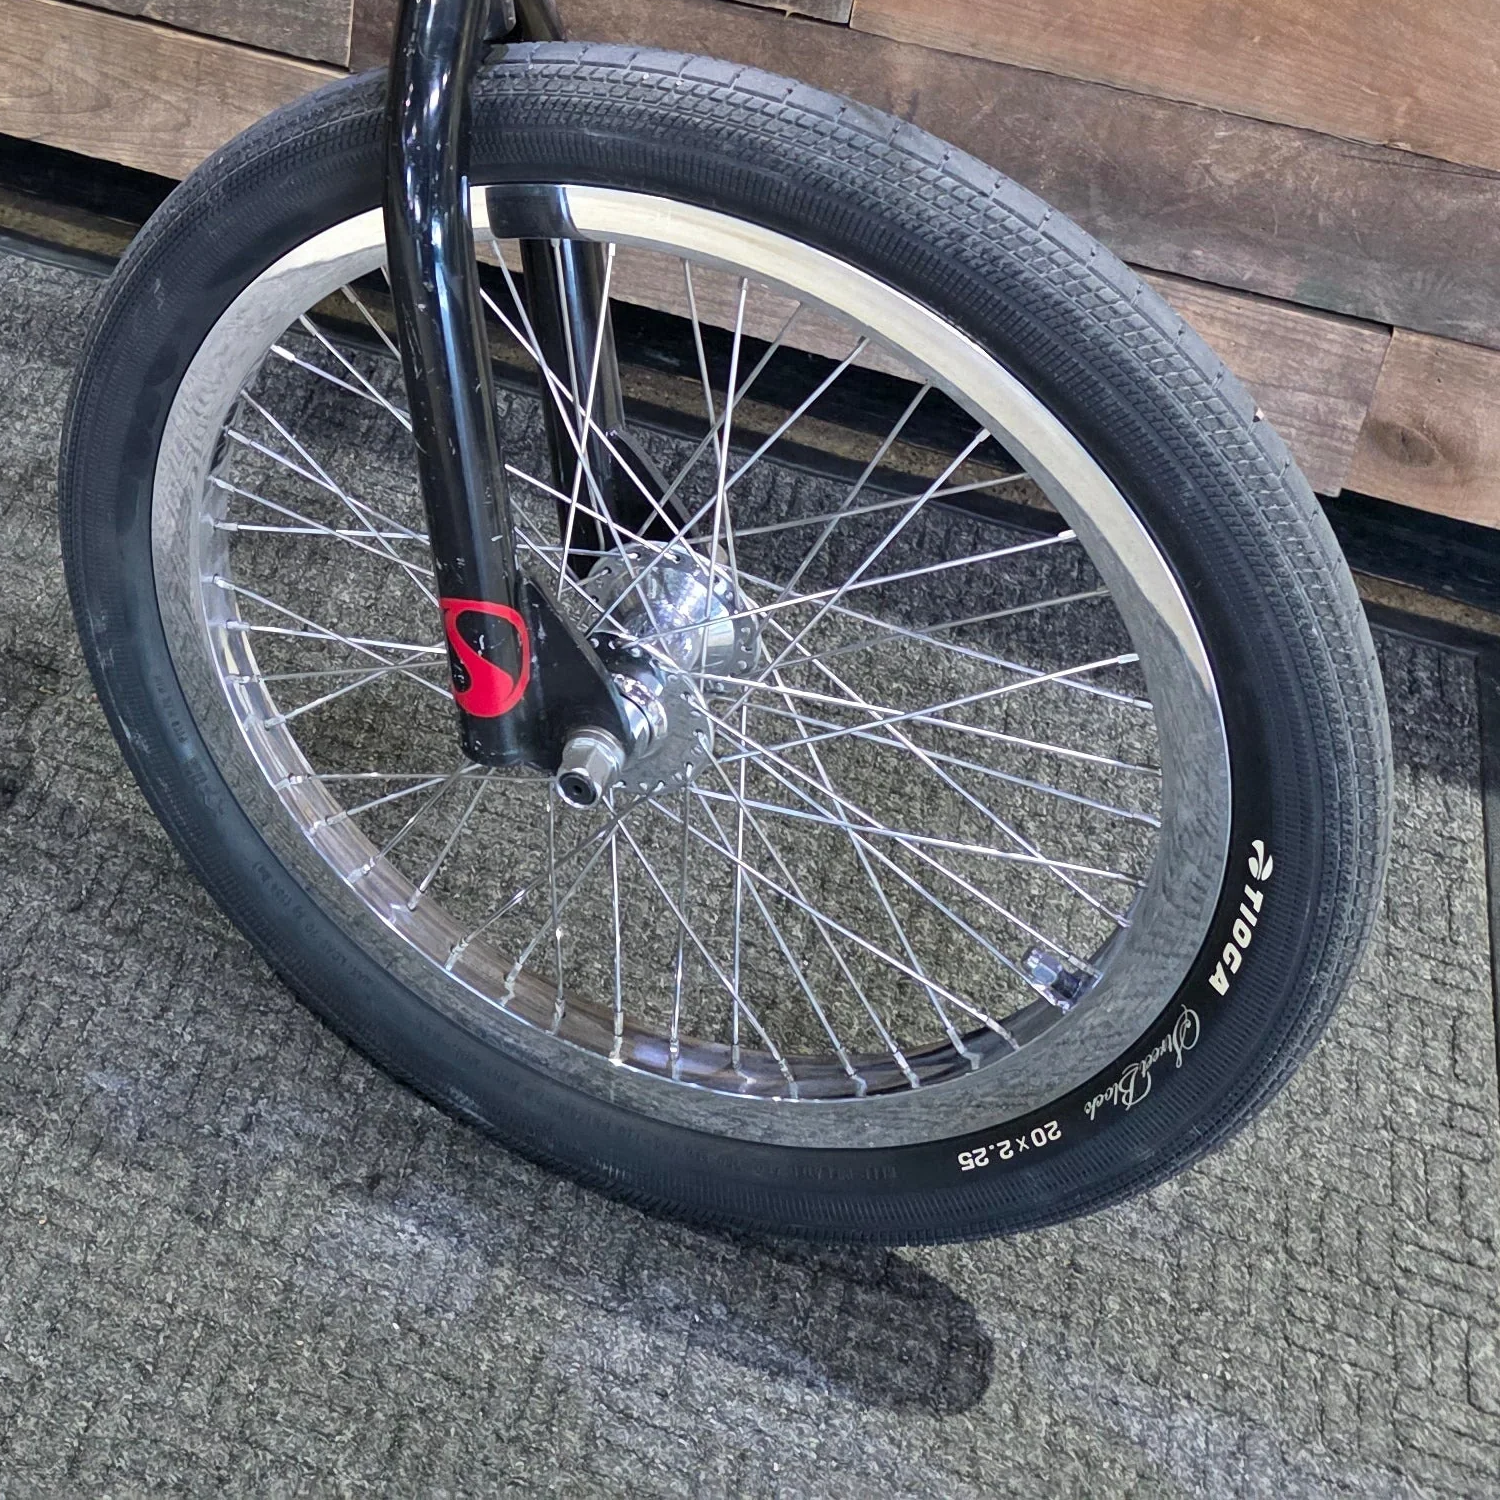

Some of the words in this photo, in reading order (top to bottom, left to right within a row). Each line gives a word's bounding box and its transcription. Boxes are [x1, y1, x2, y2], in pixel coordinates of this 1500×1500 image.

[1209, 883, 1264, 997] TIOGA
[1138, 1003, 1202, 1072] Street
[1083, 1065, 1153, 1121] Block
[957, 1141, 1015, 1172] 2.25
